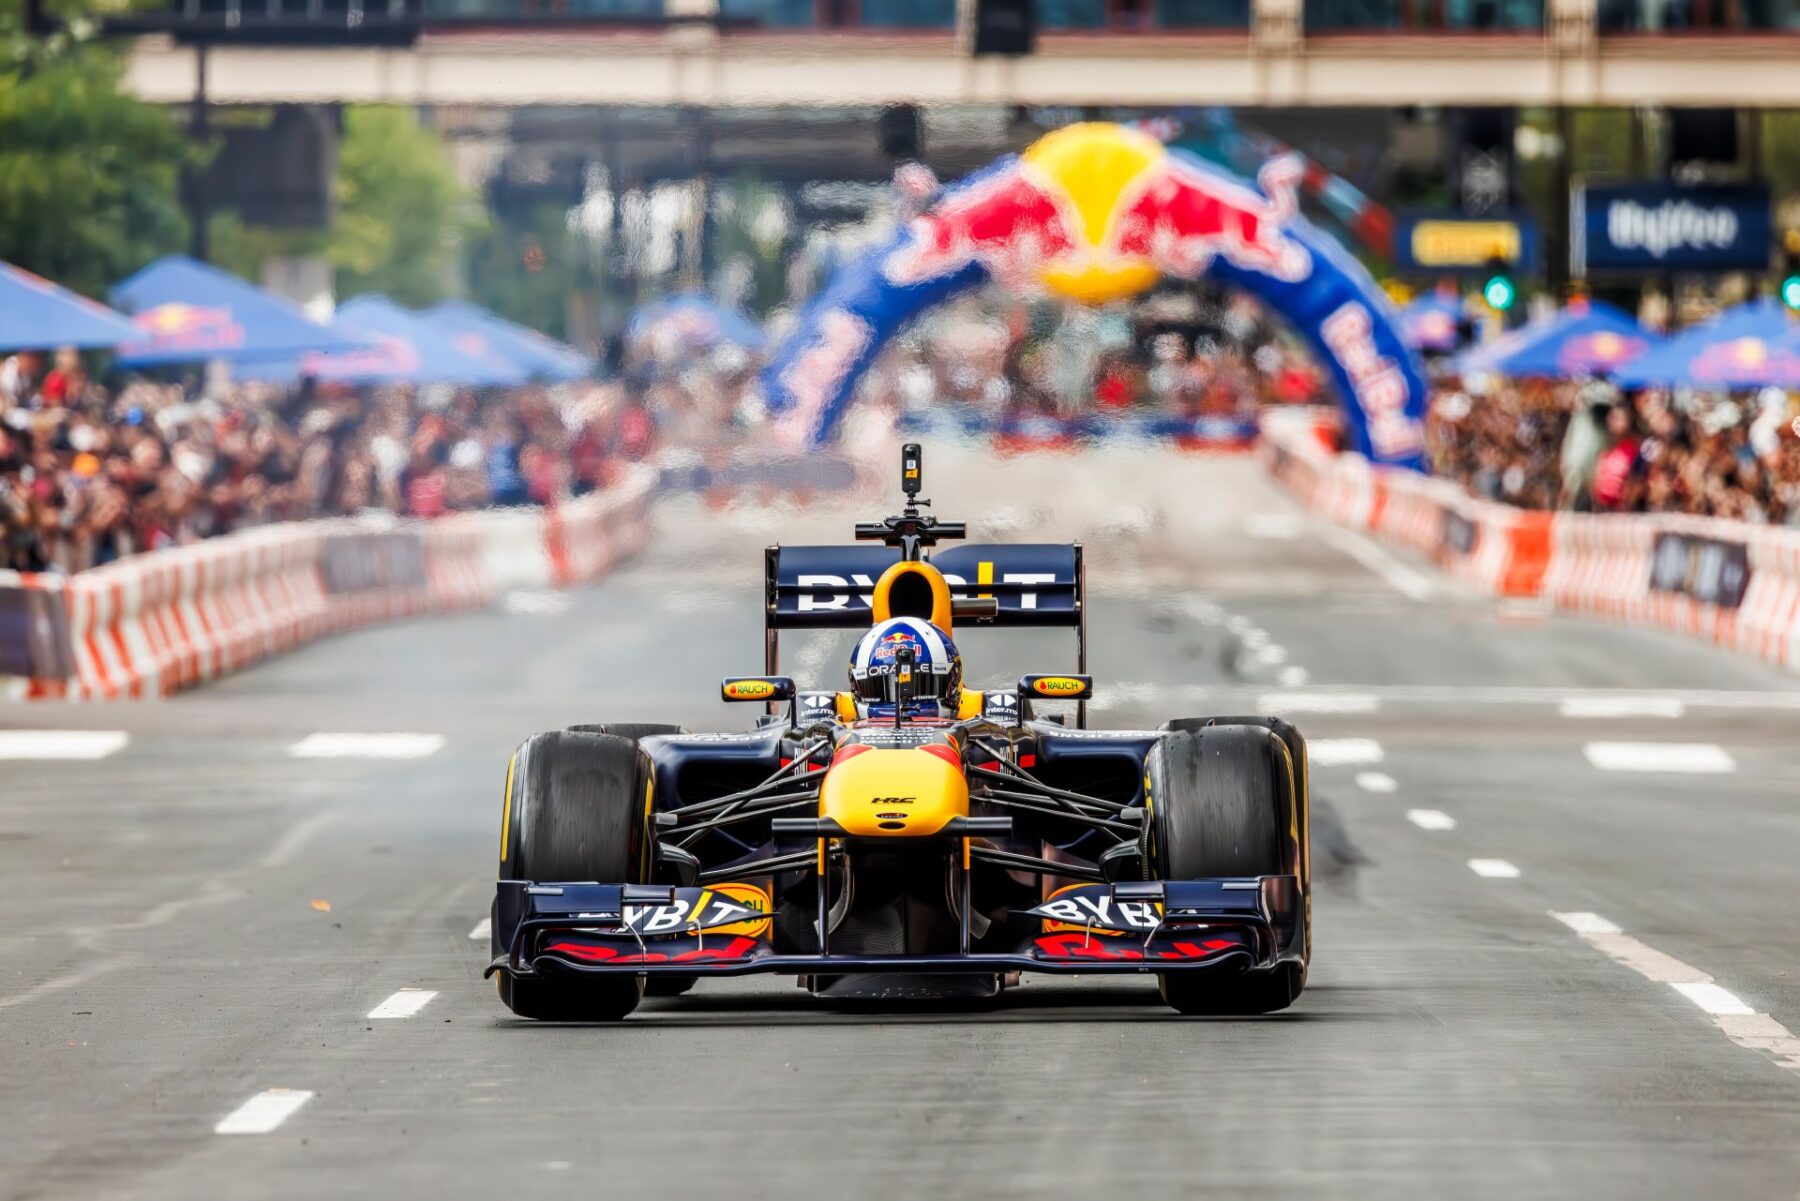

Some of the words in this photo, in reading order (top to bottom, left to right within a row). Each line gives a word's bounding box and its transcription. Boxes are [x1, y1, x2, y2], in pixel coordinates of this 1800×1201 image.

[868, 663, 930, 676] ORAE
[737, 685, 768, 694] RAUCH
[1047, 681, 1079, 690] RAUCH
[571, 891, 749, 932] YBIT
[1039, 895, 1208, 929] BYB
